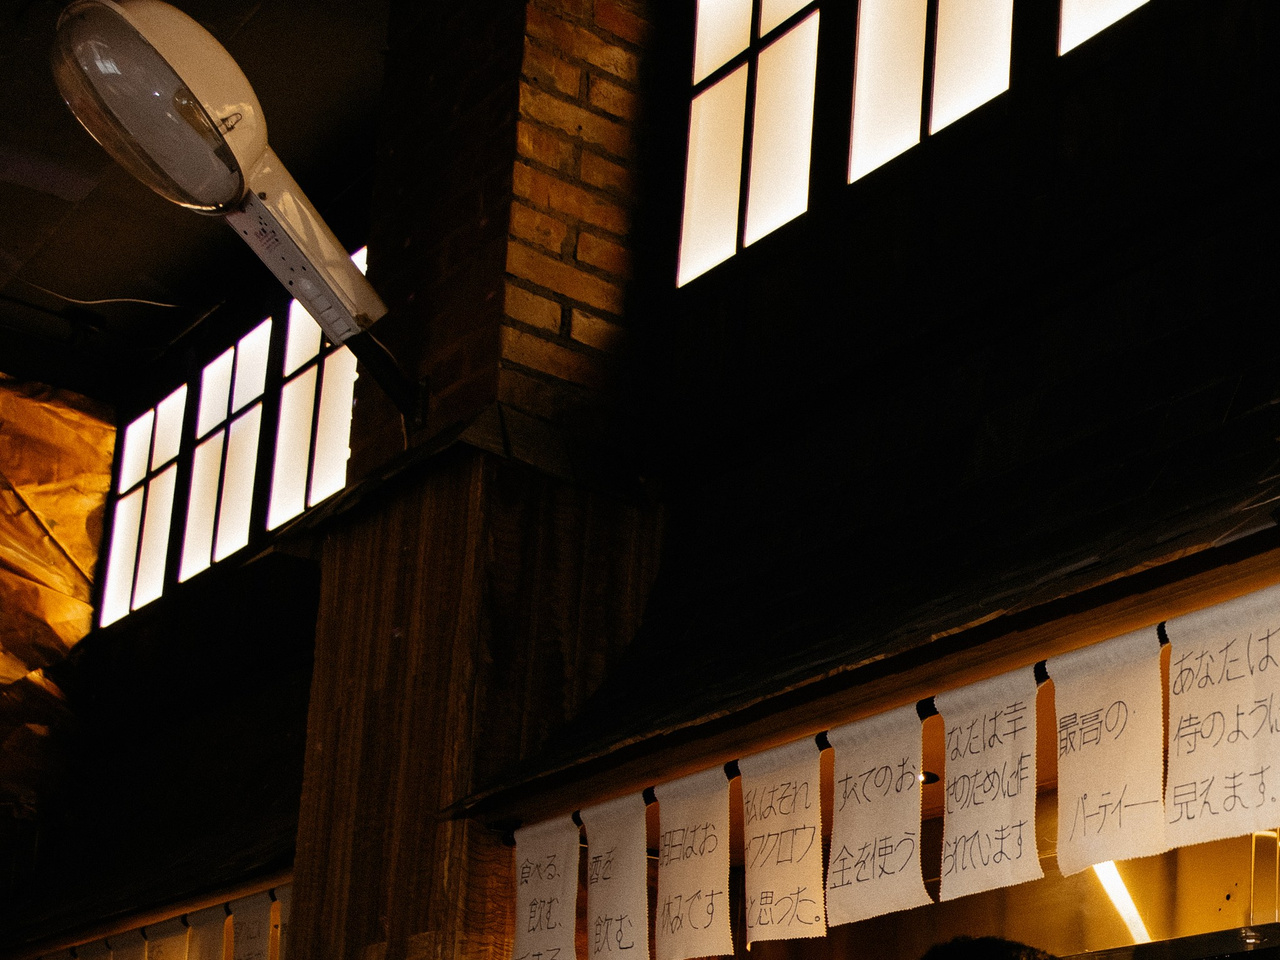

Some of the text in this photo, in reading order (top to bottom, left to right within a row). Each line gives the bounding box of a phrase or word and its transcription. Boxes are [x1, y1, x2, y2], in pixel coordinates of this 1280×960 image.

[946, 701, 1027, 761] なたは幸
[1058, 700, 1129, 760] 最高の
[744, 780, 812, 826] 私はそれ
[838, 756, 916, 812] すべてのお
[1069, 784, 1159, 842] パーティー
[1169, 765, 1277, 824] 見えます。
[829, 832, 916, 890] 金を使う
[943, 819, 1029, 877] られています
[594, 914, 634, 955] 飲む
[746, 886, 821, 929] と思った。
